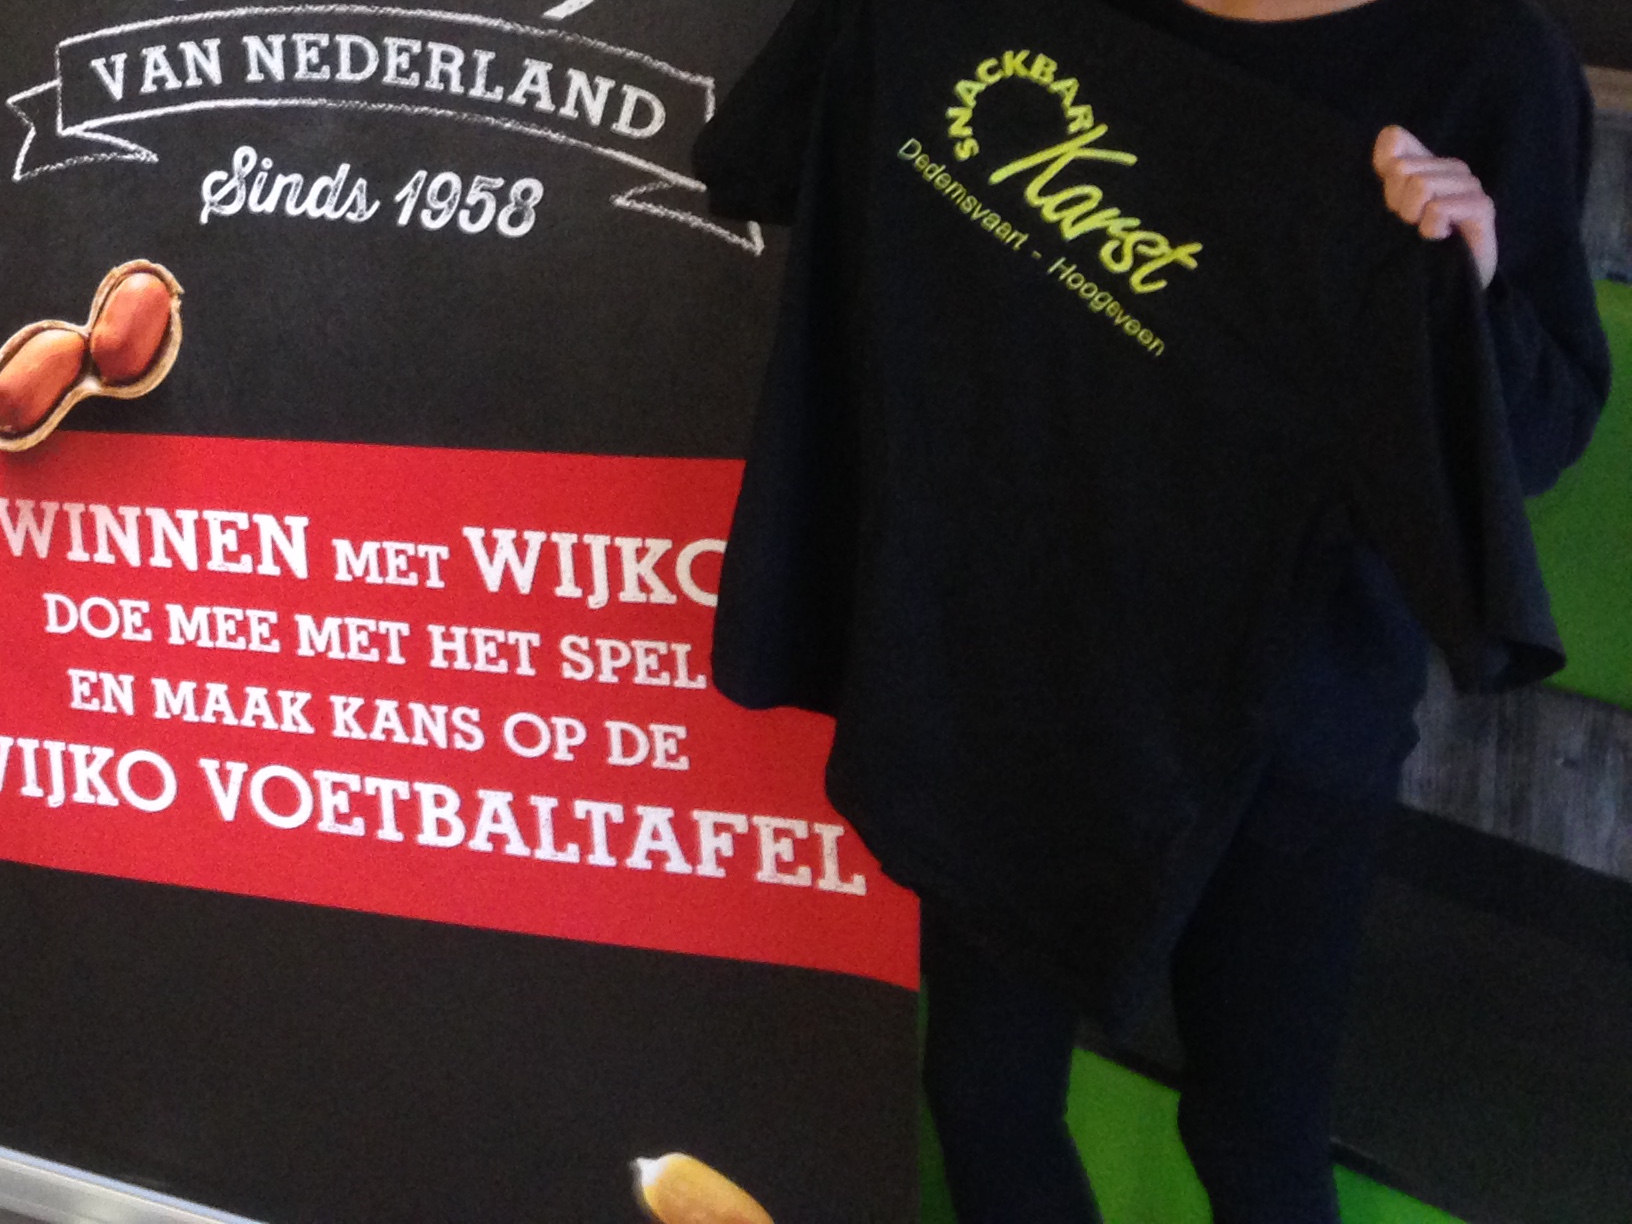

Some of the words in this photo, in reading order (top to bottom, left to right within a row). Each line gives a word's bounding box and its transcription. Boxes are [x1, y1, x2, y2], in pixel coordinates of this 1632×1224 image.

[90, 35, 223, 102] VAN
[242, 32, 667, 140] NEDERLAND
[945, 49, 1095, 162] SNACKBAR
[199, 145, 381, 225] Sinds
[393, 169, 545, 238] 1958
[988, 123, 1204, 295] Karst
[897, 137, 1030, 251] Dedemsvaart
[1047, 256, 1166, 358] Hoogeveen
[331, 538, 450, 589] MET
[42, 592, 153, 642] DOE
[165, 602, 281, 654] MEE
[294, 613, 410, 664] MET
[425, 623, 541, 676] HET
[559, 633, 707, 690] SPEL
[67, 667, 135, 716] EN
[151, 677, 315, 735] MAAK
[328, 693, 485, 752] KANS
[502, 711, 588, 762] OP
[603, 719, 690, 771] DE
[198, 756, 867, 897] VOETBALTAFEL
